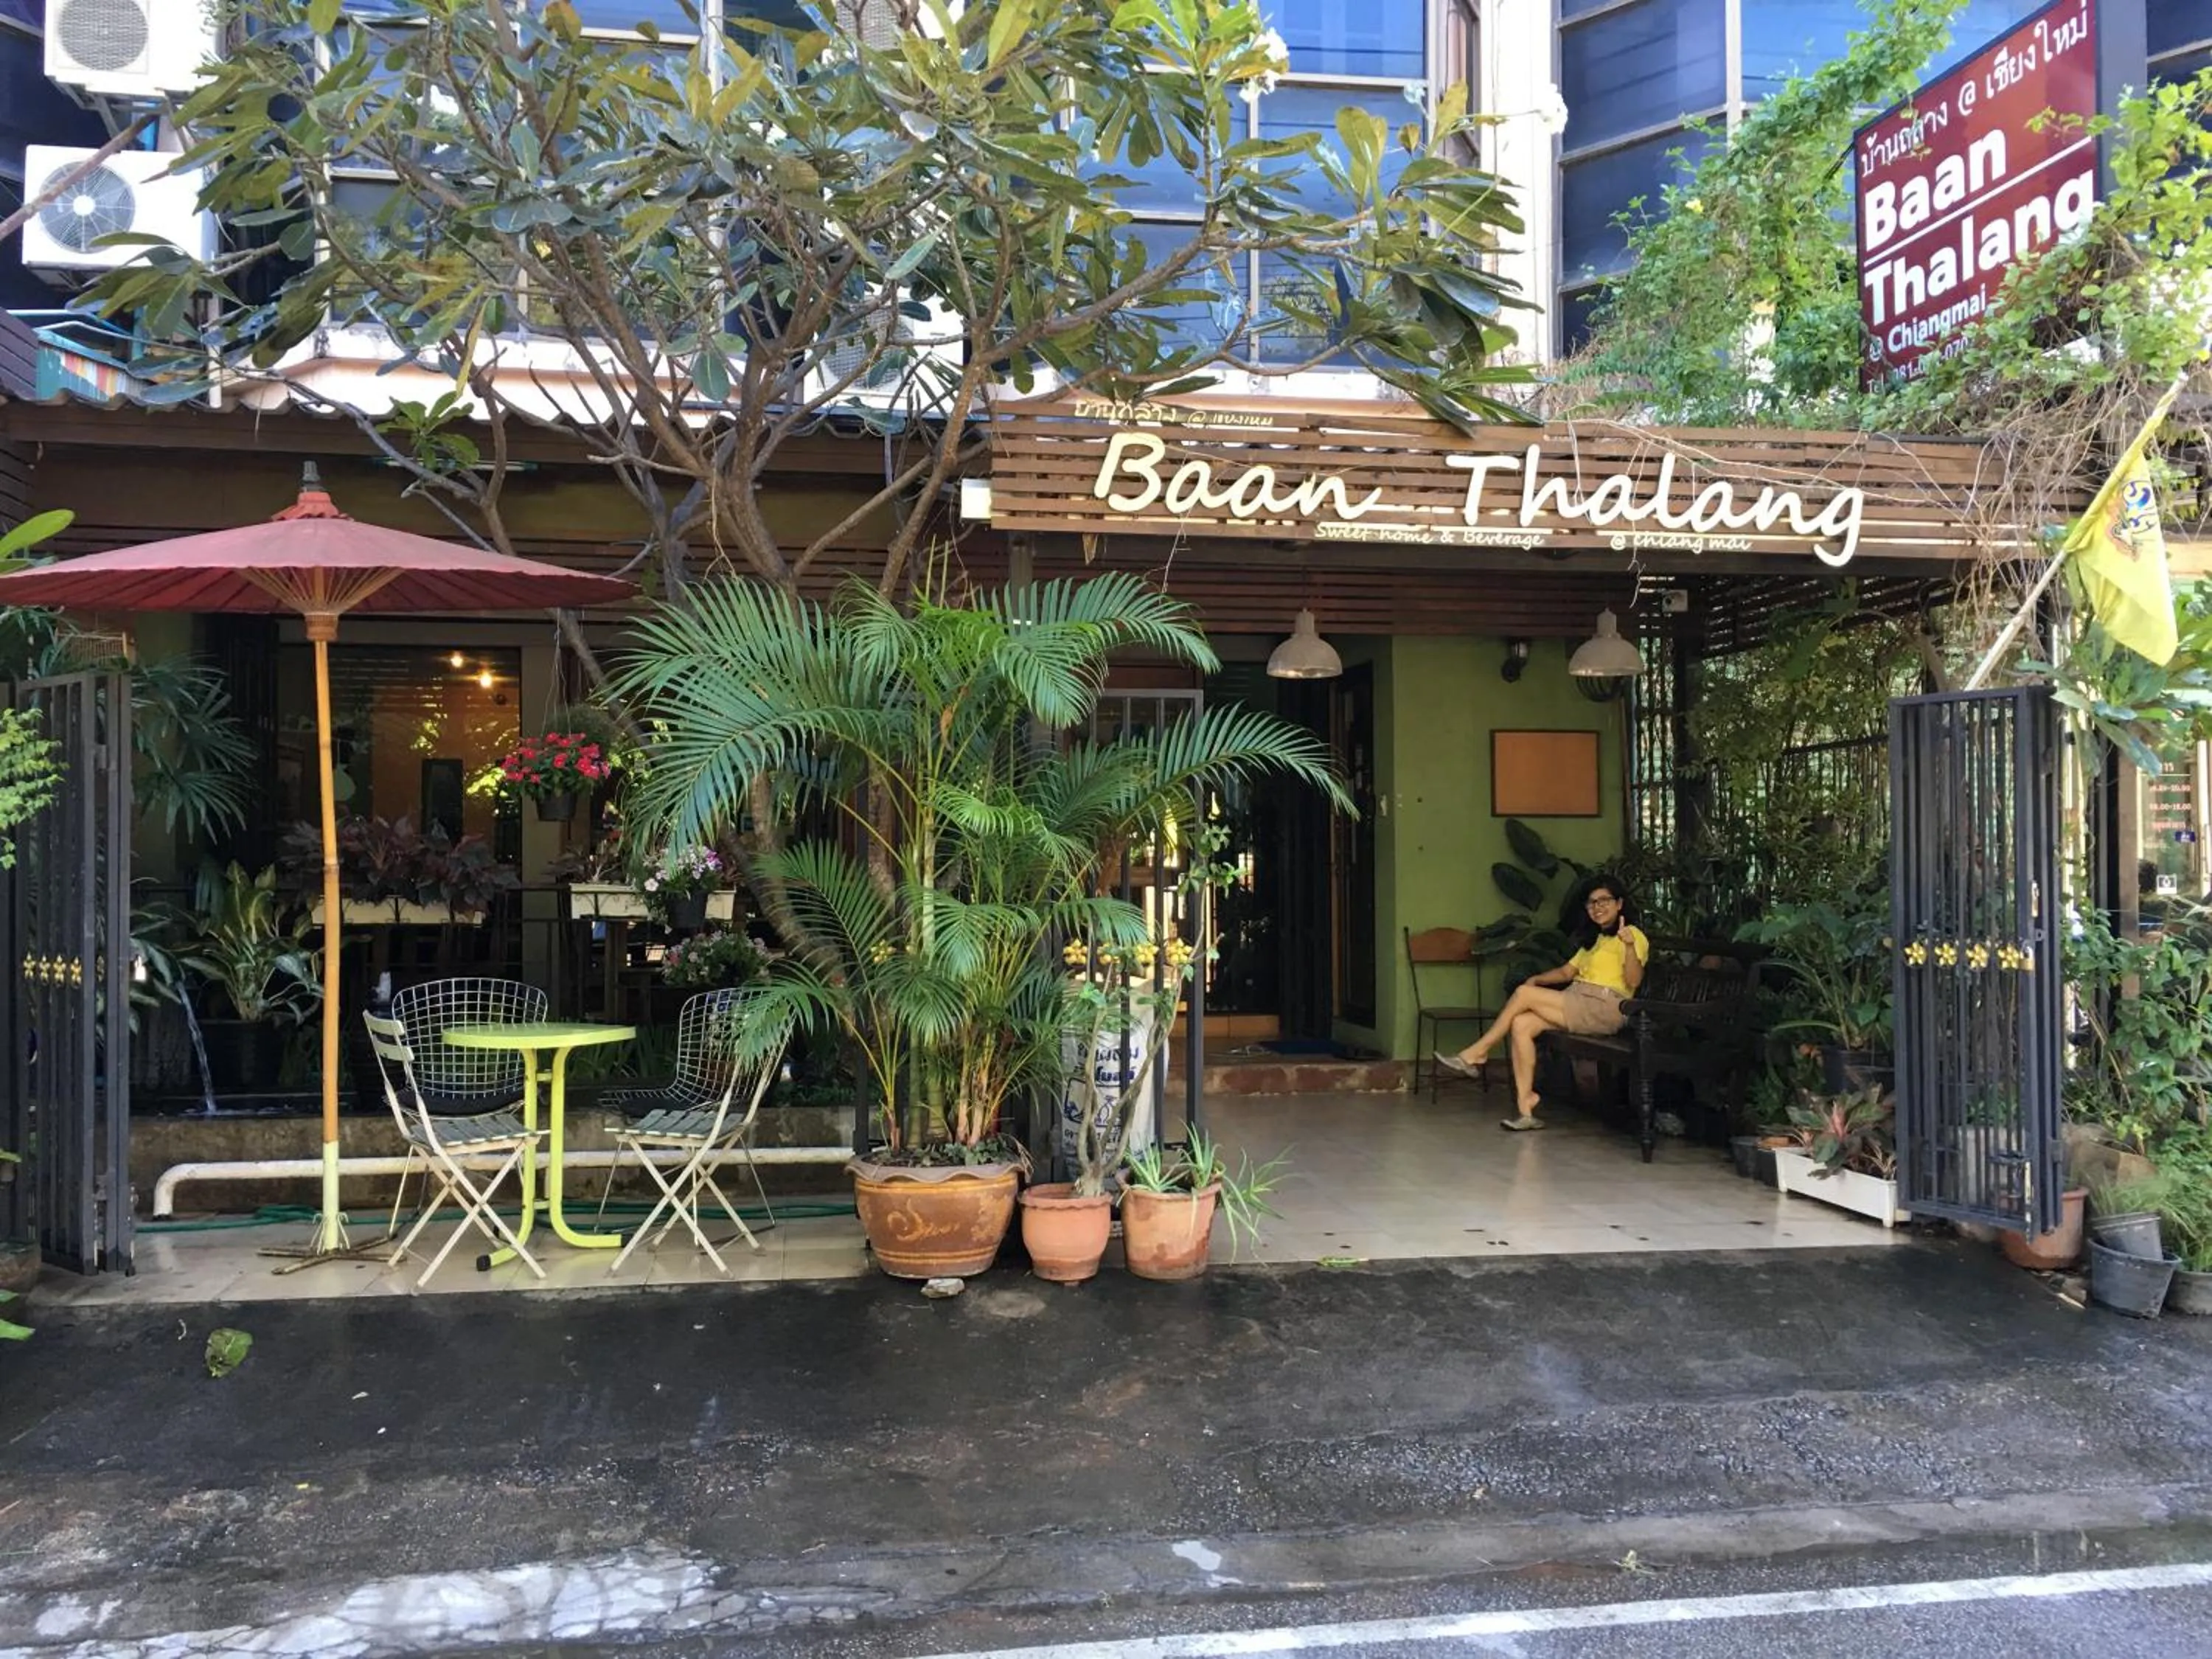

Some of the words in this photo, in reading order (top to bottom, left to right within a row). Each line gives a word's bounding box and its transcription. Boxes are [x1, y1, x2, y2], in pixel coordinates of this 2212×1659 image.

[1958, 80, 1975, 116] @
[1986, 0, 2087, 99] เชียงใหม่
[1865, 129, 2006, 251] Baan
[1865, 169, 2093, 326] Thalang
[1888, 283, 1986, 353] Chiangmai
[1188, 411, 1206, 425] @
[1094, 432, 1382, 520] Baan
[1445, 444, 1864, 567] Thalang
[1315, 524, 1370, 541] Sweet
[1379, 526, 1433, 544] home
[1441, 529, 1453, 543] &
[1463, 530, 1545, 551] Beverage
[1610, 535, 1626, 550] @
